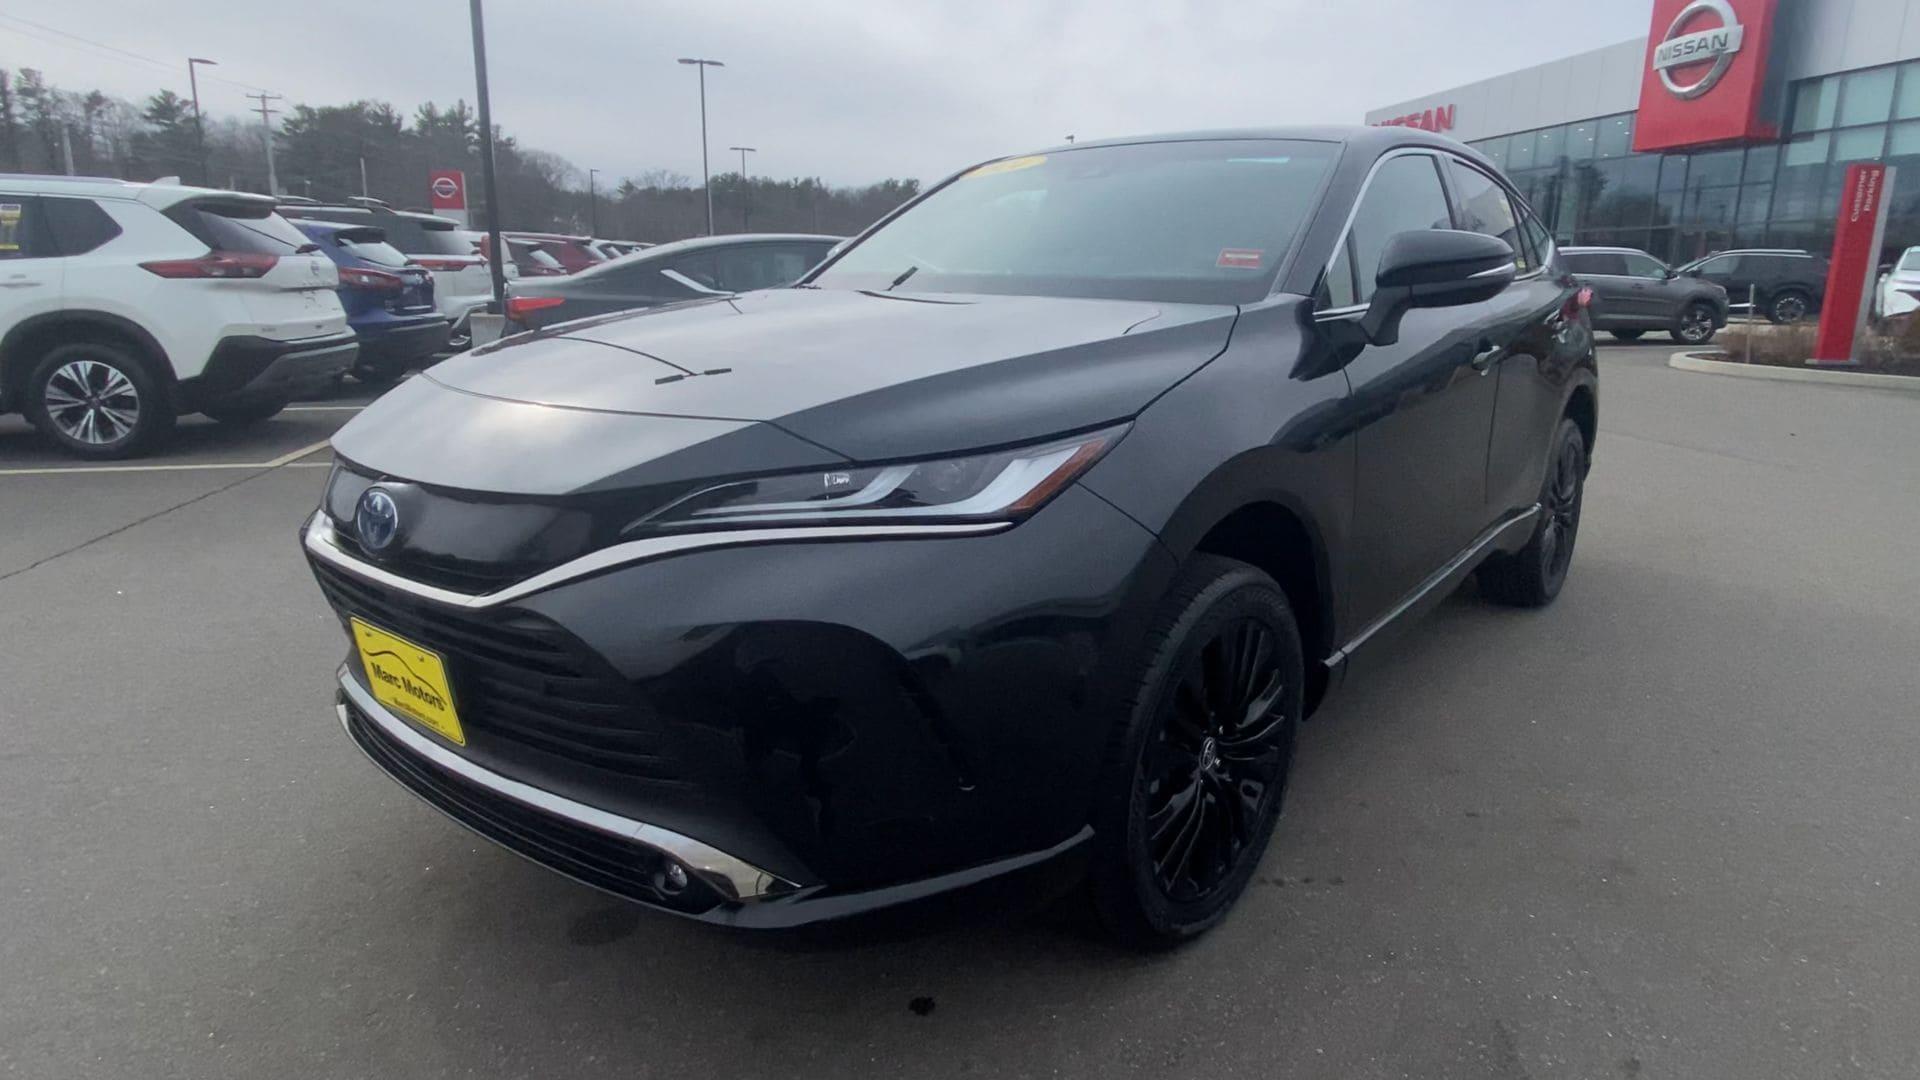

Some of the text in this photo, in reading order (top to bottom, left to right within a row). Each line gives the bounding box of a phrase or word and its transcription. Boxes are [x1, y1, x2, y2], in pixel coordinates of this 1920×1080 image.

[1660, 32, 1729, 61] NISSAN
[1371, 103, 1455, 132] SAN
[1851, 169, 1867, 222] Customer
[370, 661, 445, 711] Marc Motors
